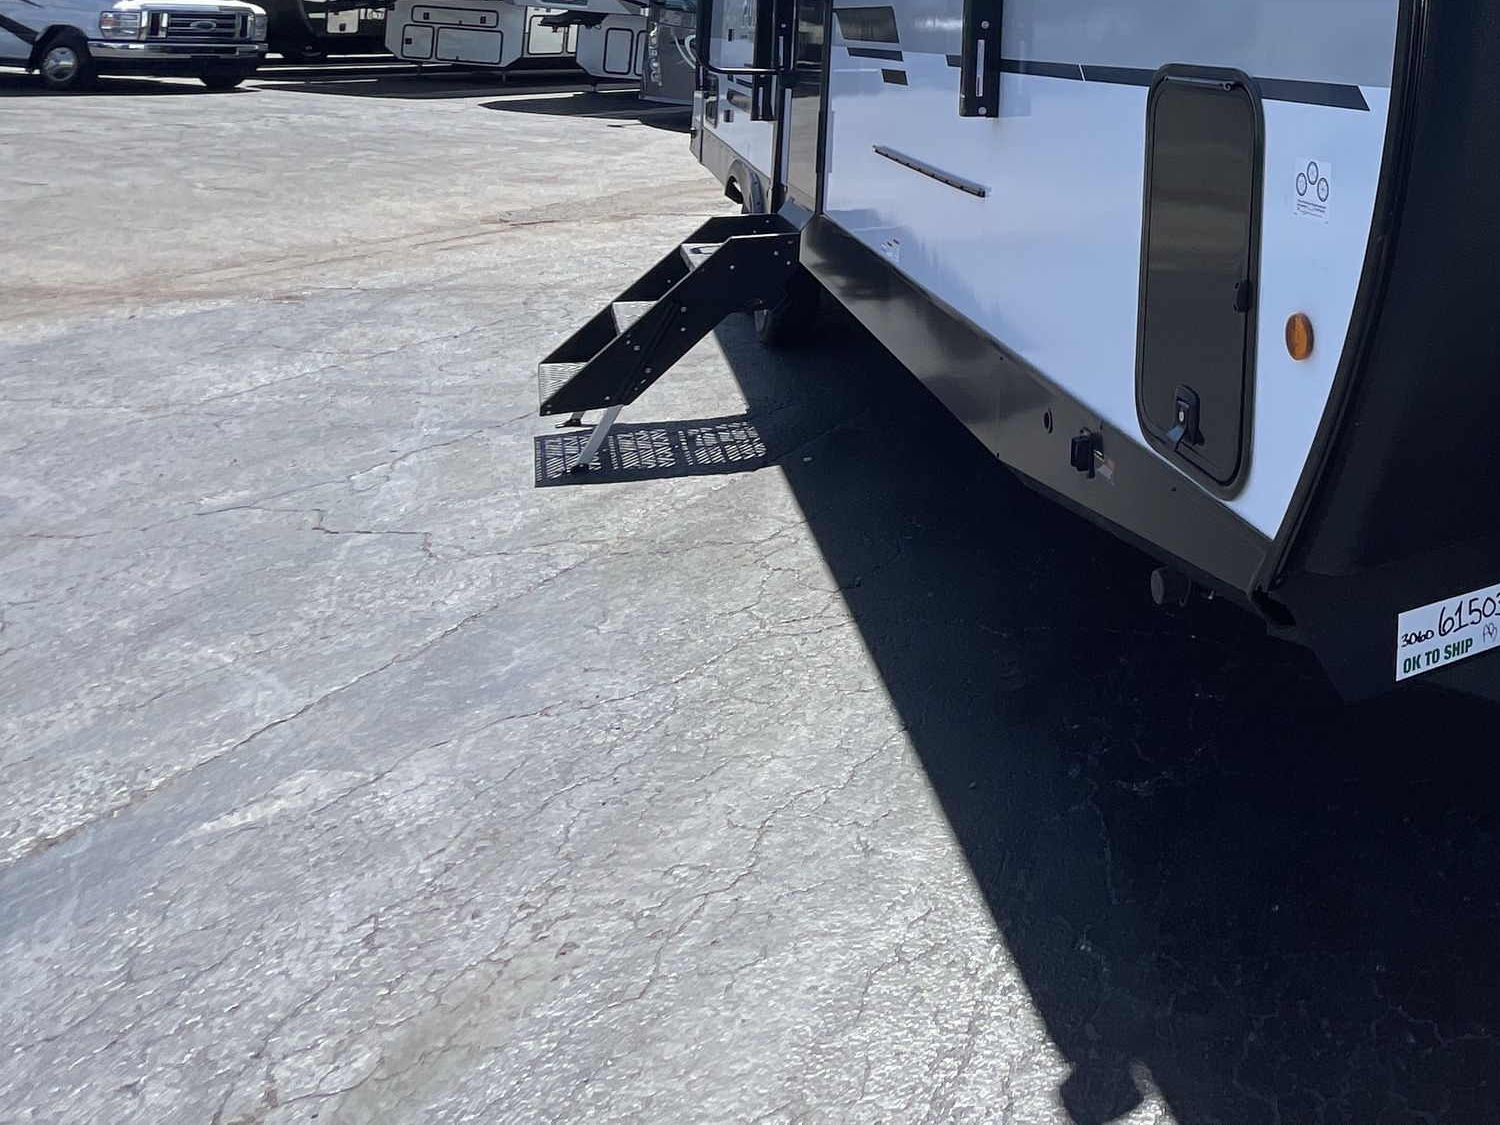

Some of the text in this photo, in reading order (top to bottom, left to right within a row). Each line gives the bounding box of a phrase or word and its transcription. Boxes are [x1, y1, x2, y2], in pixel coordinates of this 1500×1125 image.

[1401, 629, 1435, 648] 3060
[1403, 638, 1473, 674] OK TO SHIP
